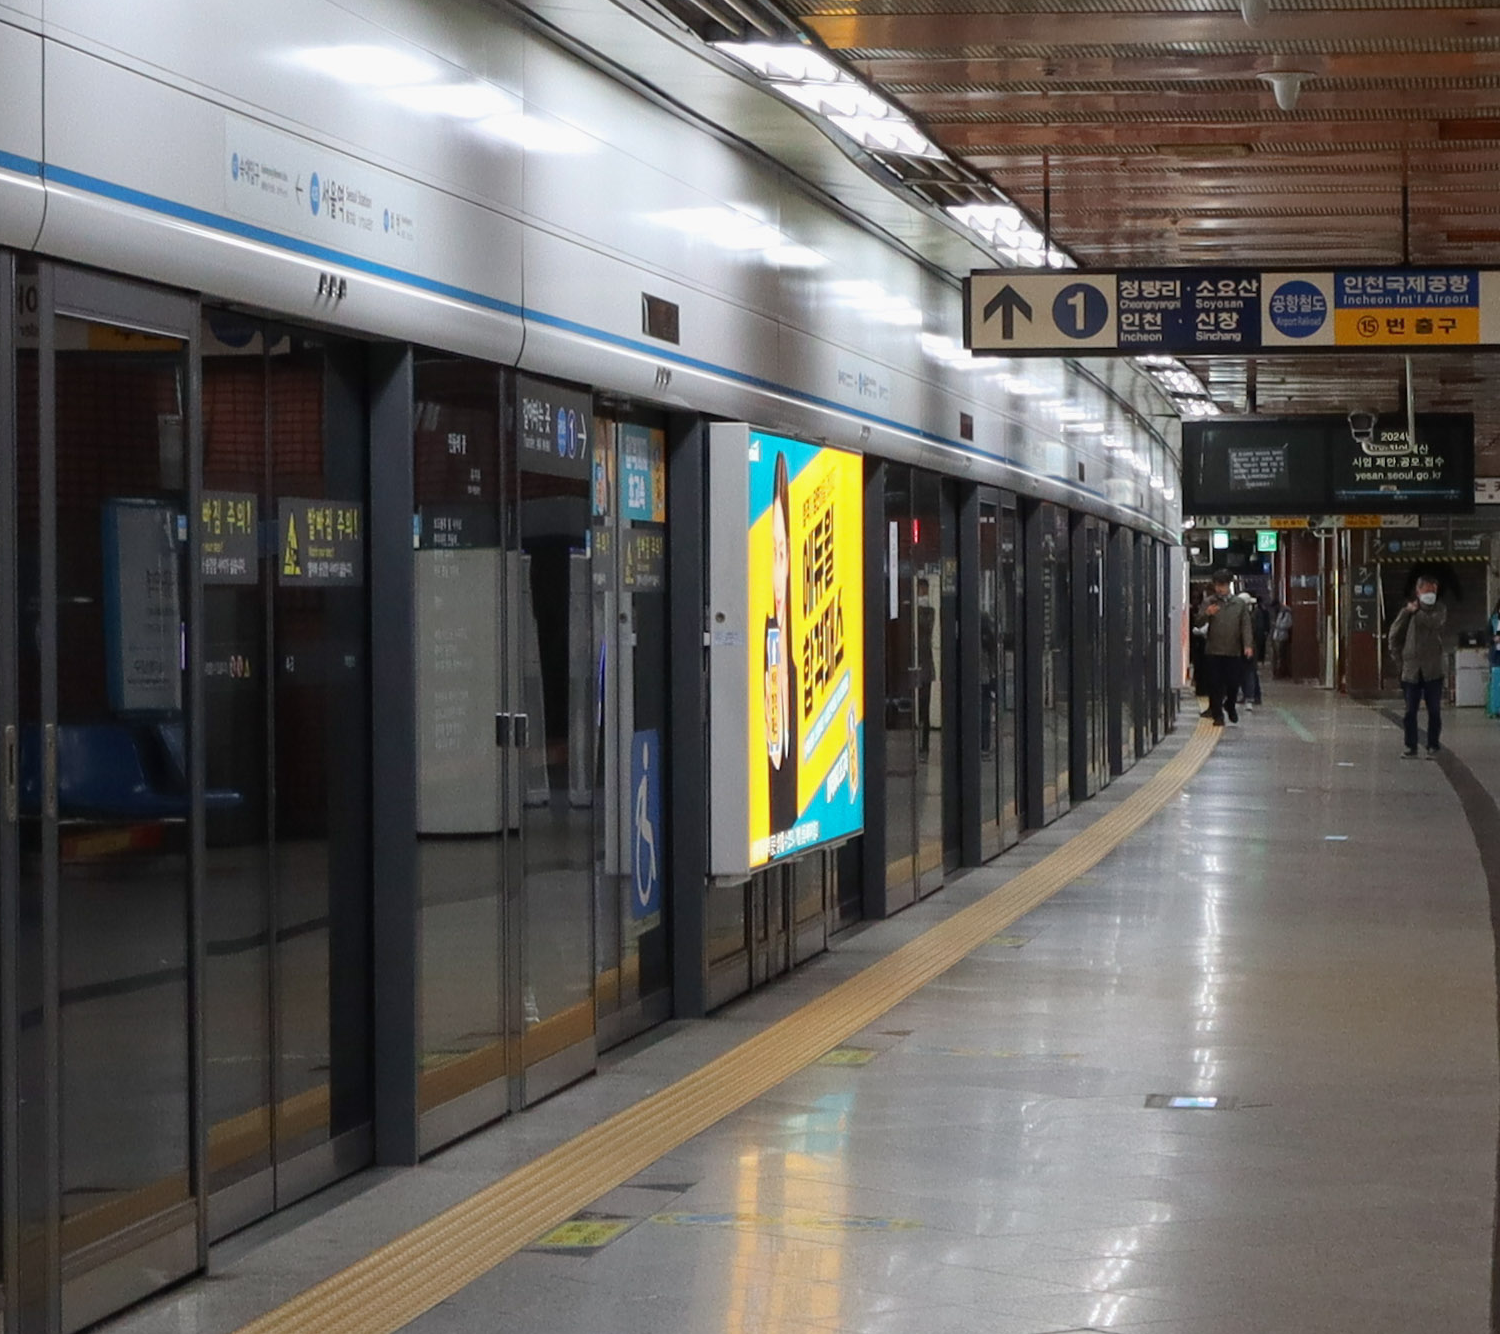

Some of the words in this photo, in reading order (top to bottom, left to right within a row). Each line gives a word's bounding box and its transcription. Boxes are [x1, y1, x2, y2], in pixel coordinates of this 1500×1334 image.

[322, 178, 345, 224] 서울역
[1119, 279, 1182, 299] 청량리
[1195, 280, 1259, 299] 소요산
[1343, 275, 1470, 294] 인천국제공항
[1271, 294, 1327, 314] 공항철도
[1343, 294, 1393, 306] Incheon
[1425, 294, 1470, 305] Airport
[1066, 291, 1087, 331] 1
[1120, 312, 1162, 331] 인천
[1195, 312, 1239, 331] 신창
[1387, 317, 1405, 335] 번
[1415, 316, 1458, 335] 출구
[1120, 331, 1163, 343] Incheon
[1195, 331, 1242, 344] Sinchang
[1352, 456, 1373, 468] 사업
[1355, 470, 1442, 482] yesan.seoul.go.kr
[202, 498, 222, 535] 빠짐
[803, 503, 835, 620] 에듀윌
[803, 587, 845, 723] 합격패스
